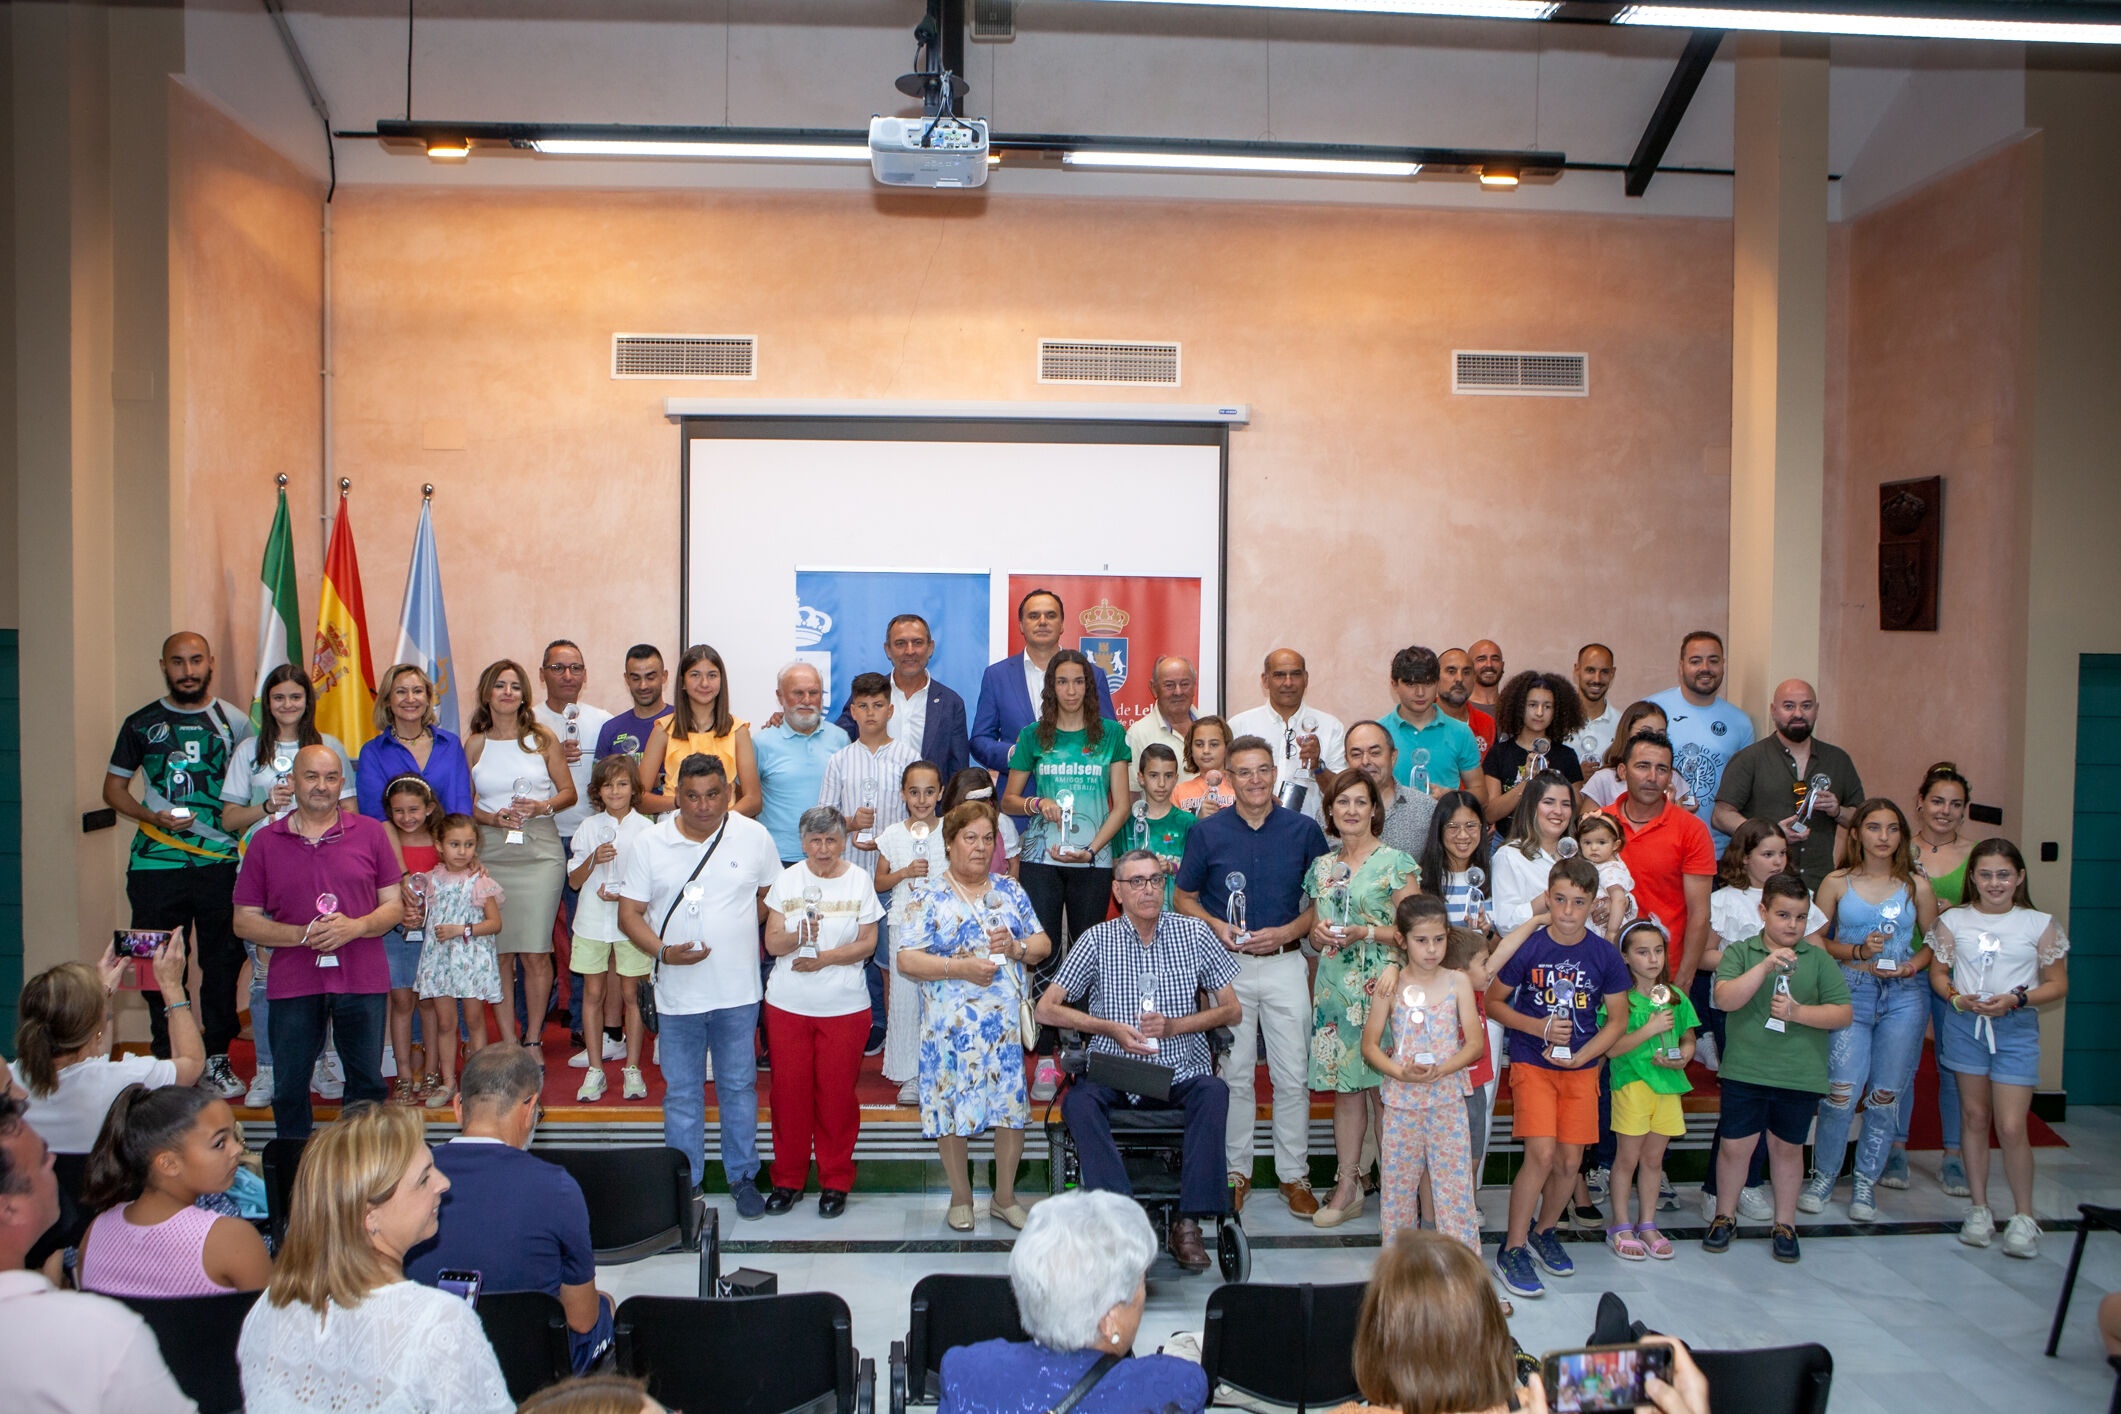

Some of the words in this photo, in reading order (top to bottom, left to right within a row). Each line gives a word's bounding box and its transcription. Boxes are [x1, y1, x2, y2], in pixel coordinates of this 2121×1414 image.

[1115, 703, 1131, 716] de
[185, 741, 200, 764] 9
[1534, 988, 1587, 1009] SOE
